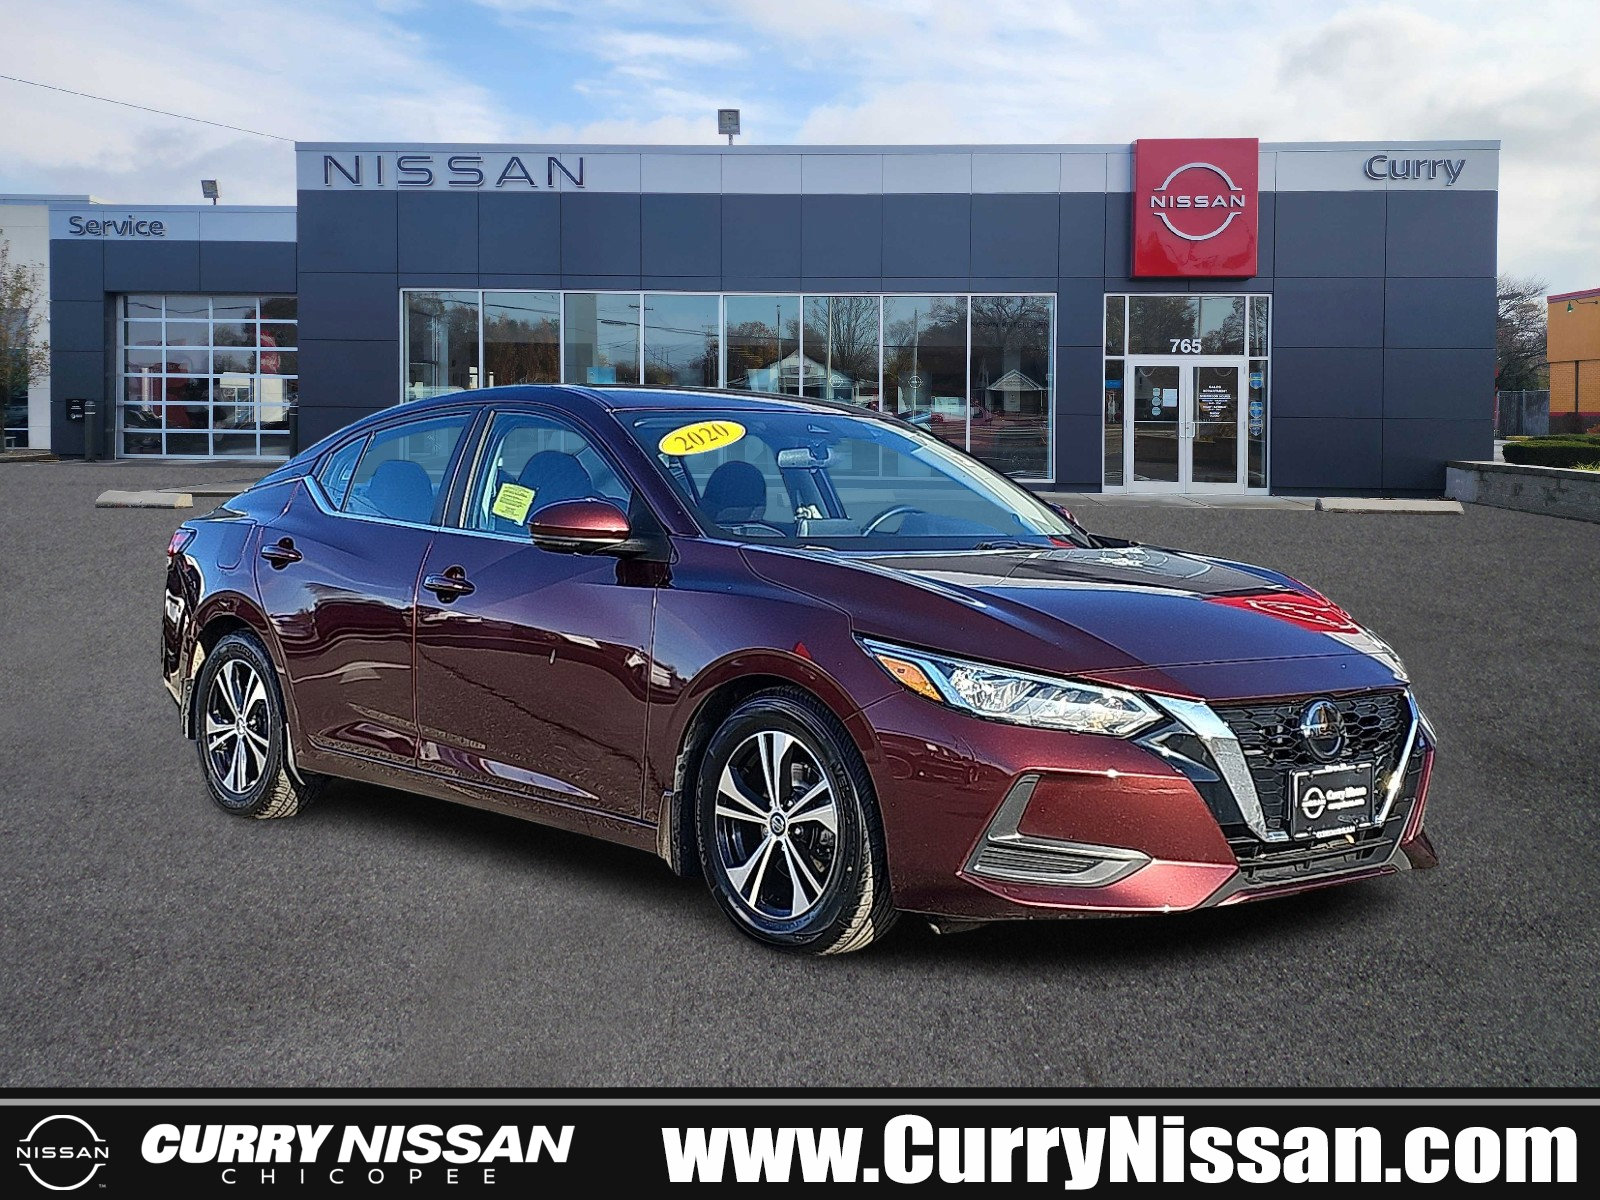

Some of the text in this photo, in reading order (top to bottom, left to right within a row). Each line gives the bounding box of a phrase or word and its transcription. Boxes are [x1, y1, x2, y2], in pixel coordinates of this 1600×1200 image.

[323, 155, 586, 188] NISSAN
[1364, 154, 1466, 186] Curry
[1150, 195, 1246, 208] NISSAN
[68, 214, 166, 236] Service
[1169, 338, 1202, 354] 765
[674, 423, 730, 451] 2020
